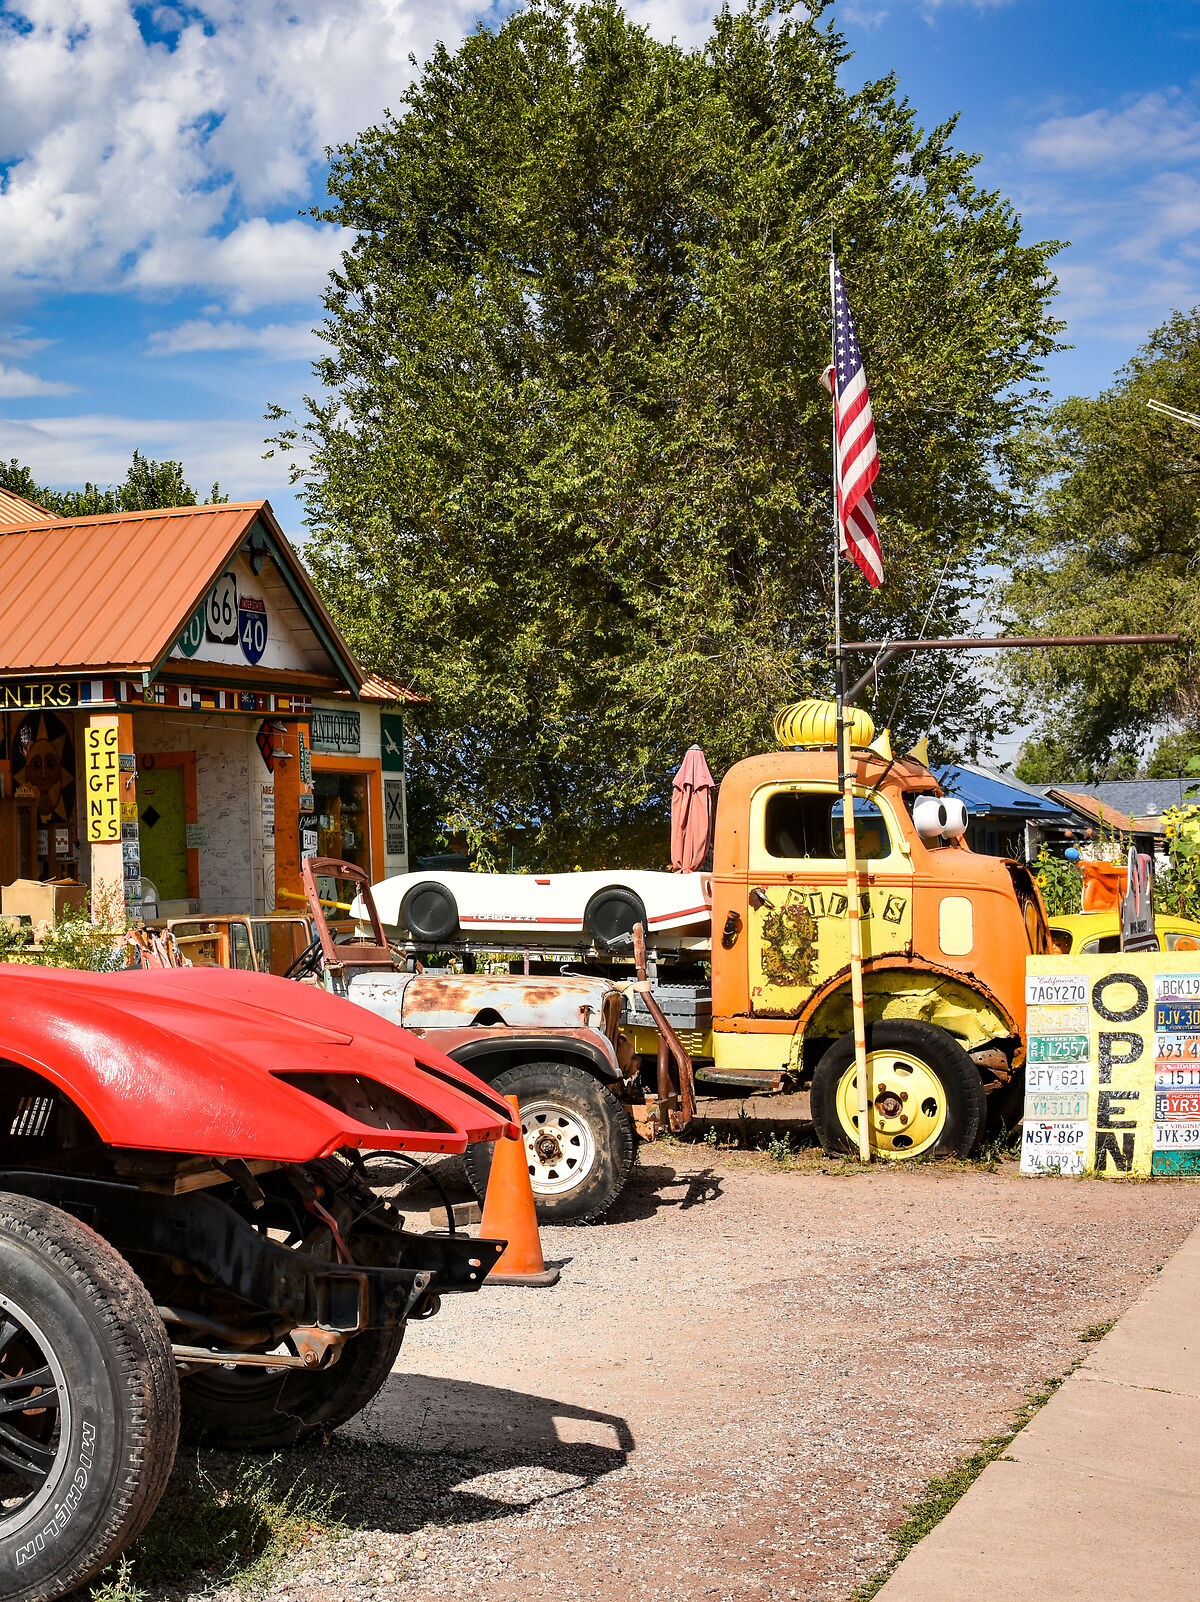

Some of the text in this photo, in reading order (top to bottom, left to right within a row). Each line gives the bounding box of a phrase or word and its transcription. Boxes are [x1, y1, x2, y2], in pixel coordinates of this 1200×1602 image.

[212, 587, 232, 625] 66
[242, 620, 264, 652] 40
[312, 713, 360, 751] ANTIQUES
[89, 730, 103, 839] SIGNS
[104, 728, 118, 838] GIFTS
[1029, 985, 1085, 1001] 7AGY270
[1162, 979, 1200, 995] BGK19
[1048, 1040, 1088, 1057] 12557
[1061, 1070, 1085, 1086] 621
[1091, 972, 1149, 1173] OPEN
[14, 1420, 96, 1567] MICHELIN
